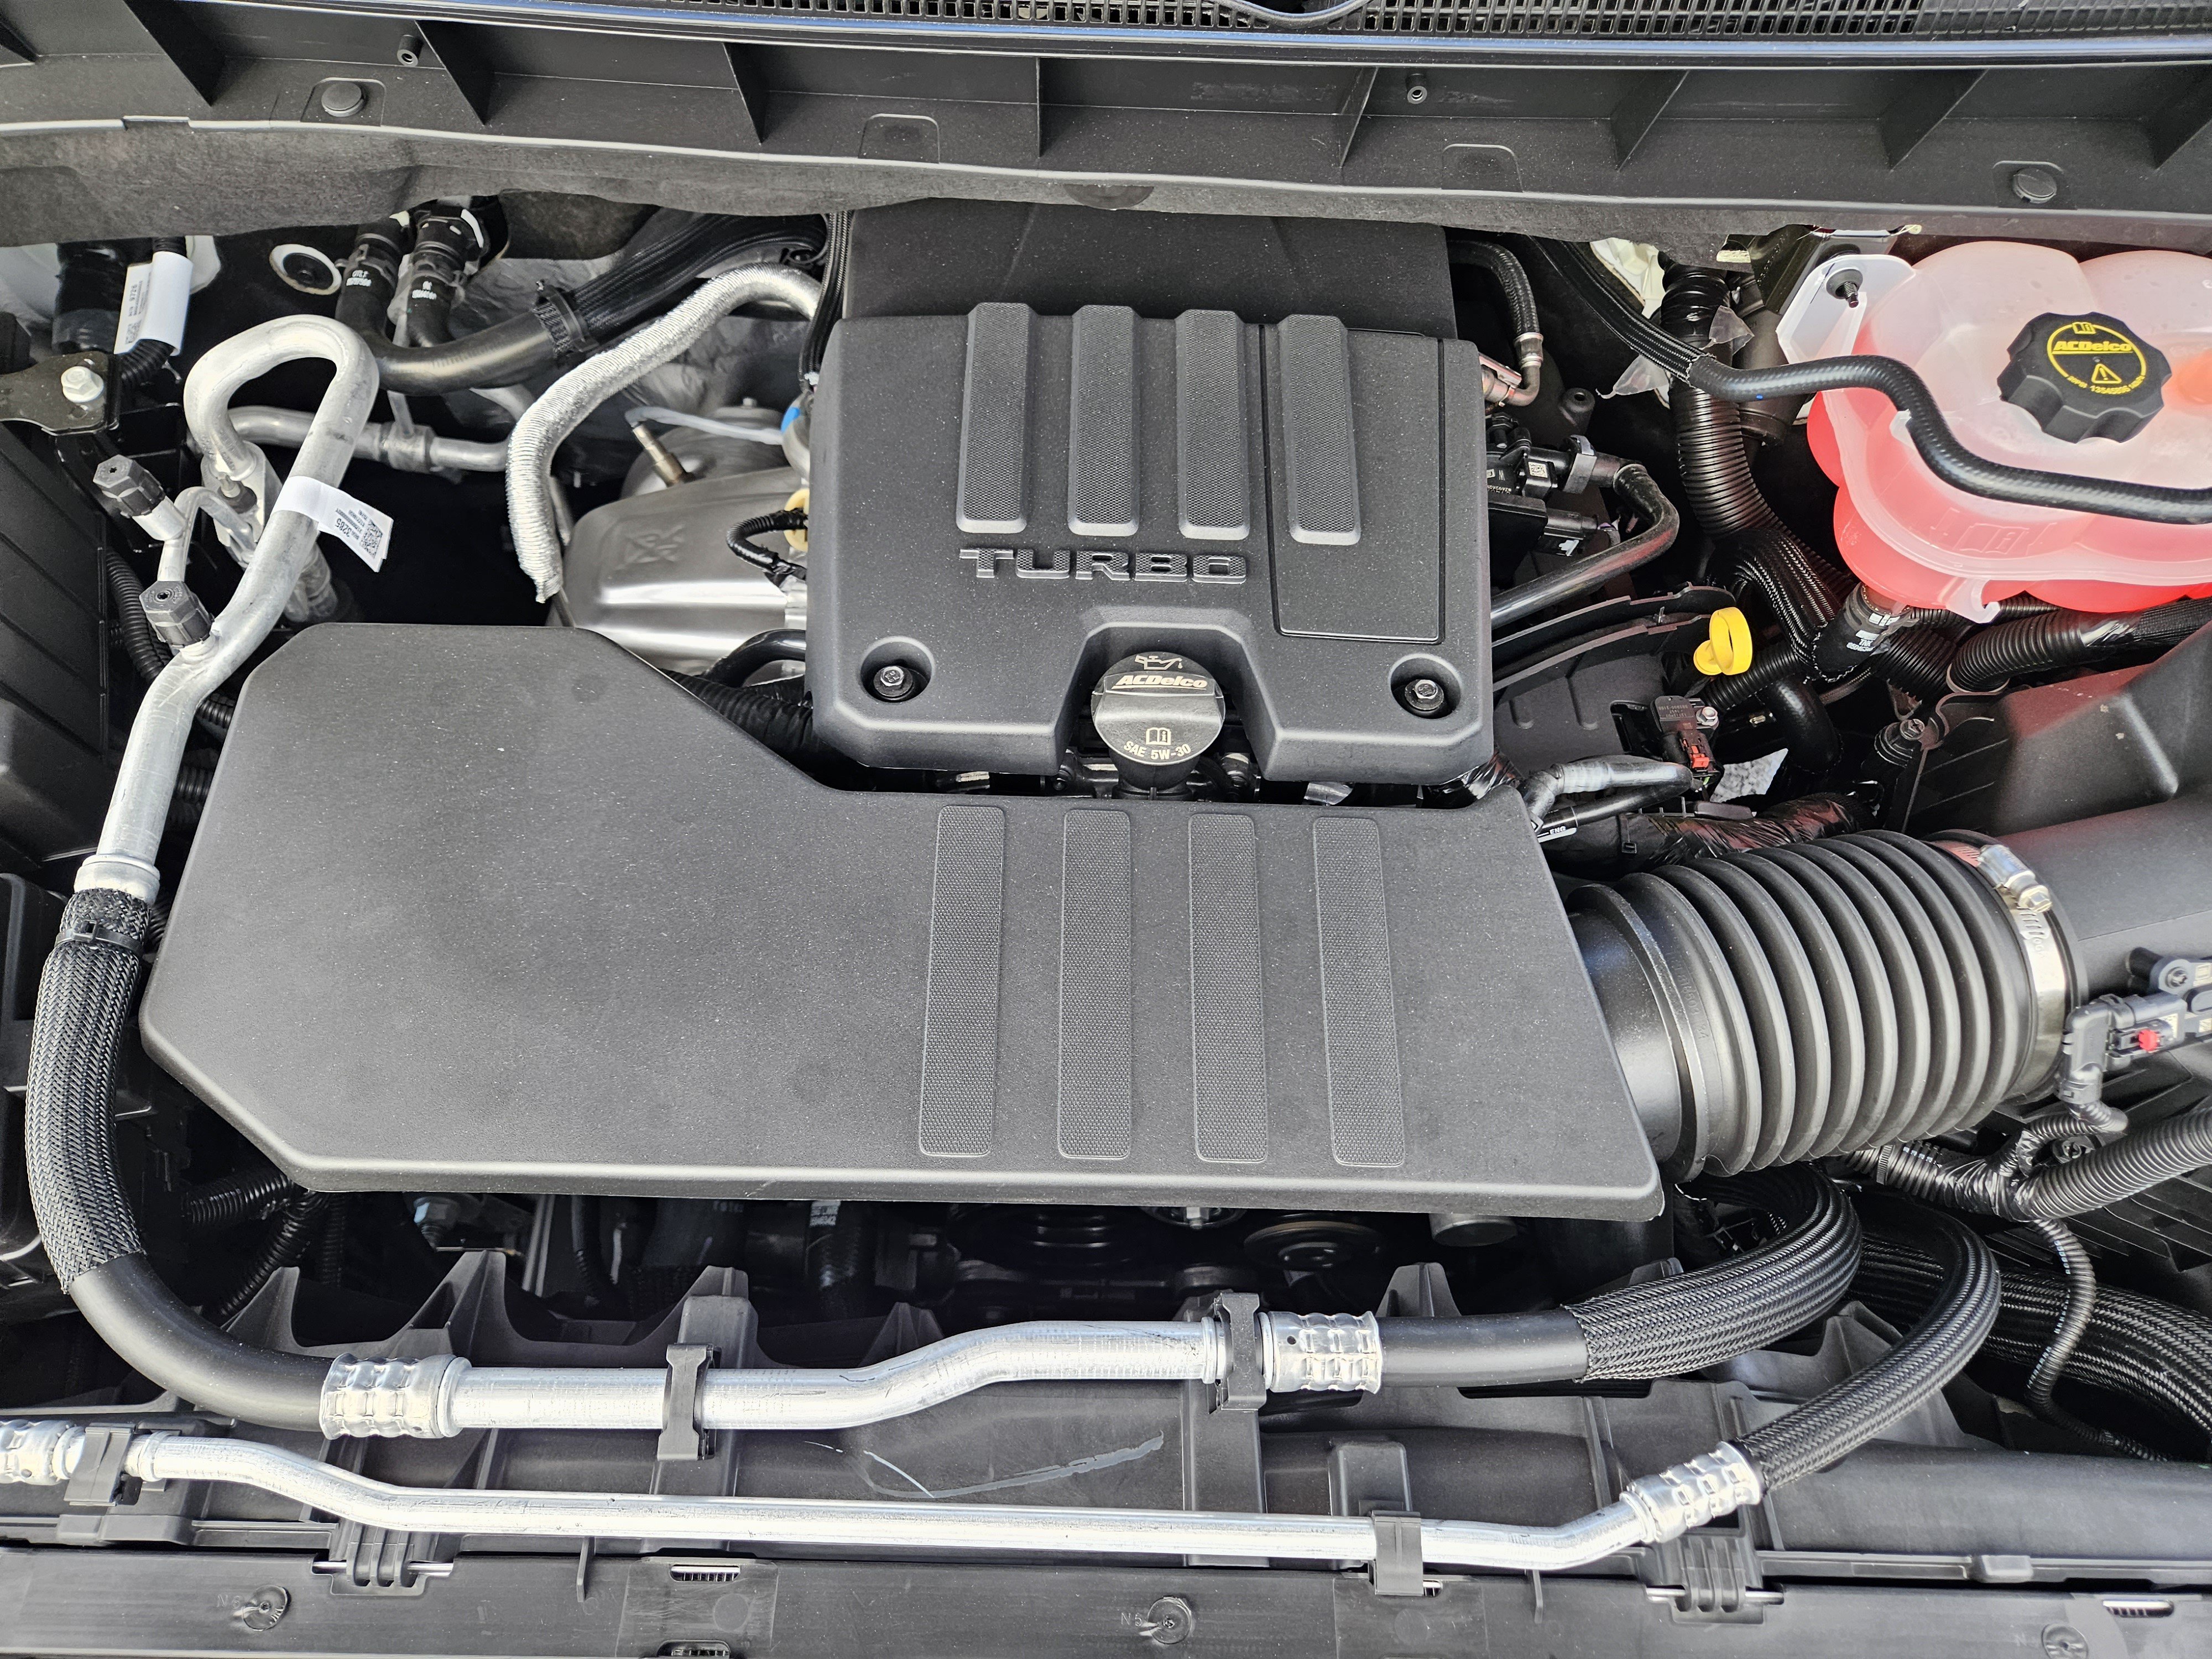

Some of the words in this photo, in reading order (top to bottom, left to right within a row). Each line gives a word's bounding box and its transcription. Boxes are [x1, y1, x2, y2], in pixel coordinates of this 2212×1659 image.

[2053, 340, 2132, 351] ACDelco
[335, 518, 352, 537] 3285
[959, 548, 1247, 585] TURBO
[1115, 675, 1208, 688] ACDelco
[1123, 741, 1147, 757] SAE
[1150, 743, 1191, 761] 5W-30
[1550, 826, 1567, 835] ENG
